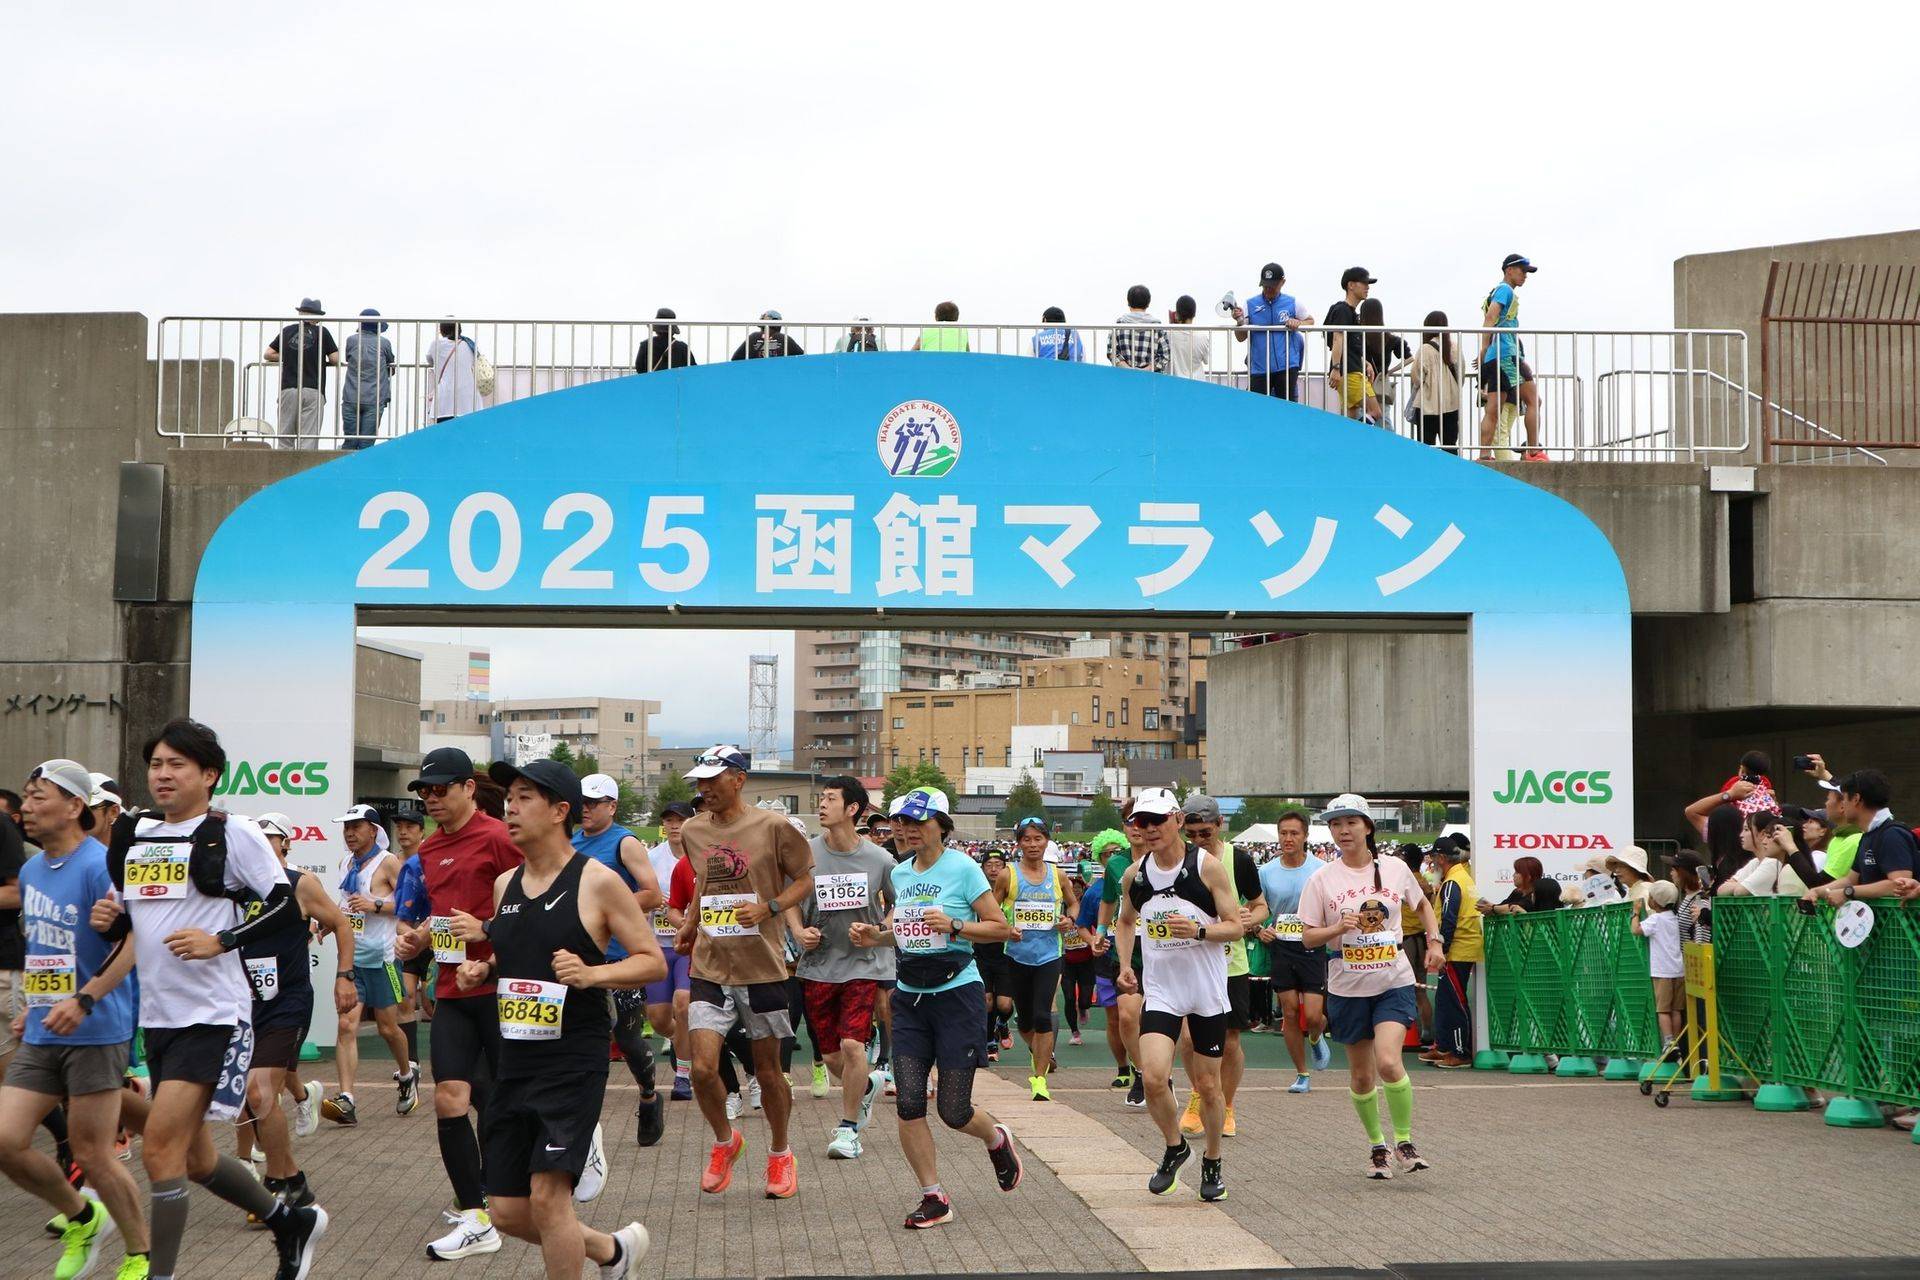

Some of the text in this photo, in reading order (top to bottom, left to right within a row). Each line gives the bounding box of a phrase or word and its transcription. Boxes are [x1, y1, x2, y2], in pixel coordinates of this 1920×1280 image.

[880, 403, 958, 443] HAKODATE MARATHON
[357, 491, 1465, 597] 2025 函館マラソン
[5, 693, 125, 715] メインゲート
[213, 761, 330, 795] JACCS
[1493, 769, 1613, 804] JACCS
[1493, 834, 1614, 849] HONDA
[141, 846, 175, 857] JACCS
[831, 875, 852, 883] SEC
[1555, 873, 1579, 881] Cars
[24, 884, 53, 917] RUN
[823, 901, 862, 909] HONDA
[717, 926, 741, 935] SEC
[905, 939, 931, 948] JACCS
[1357, 935, 1380, 944] SEC
[1350, 962, 1392, 970] HONDA
